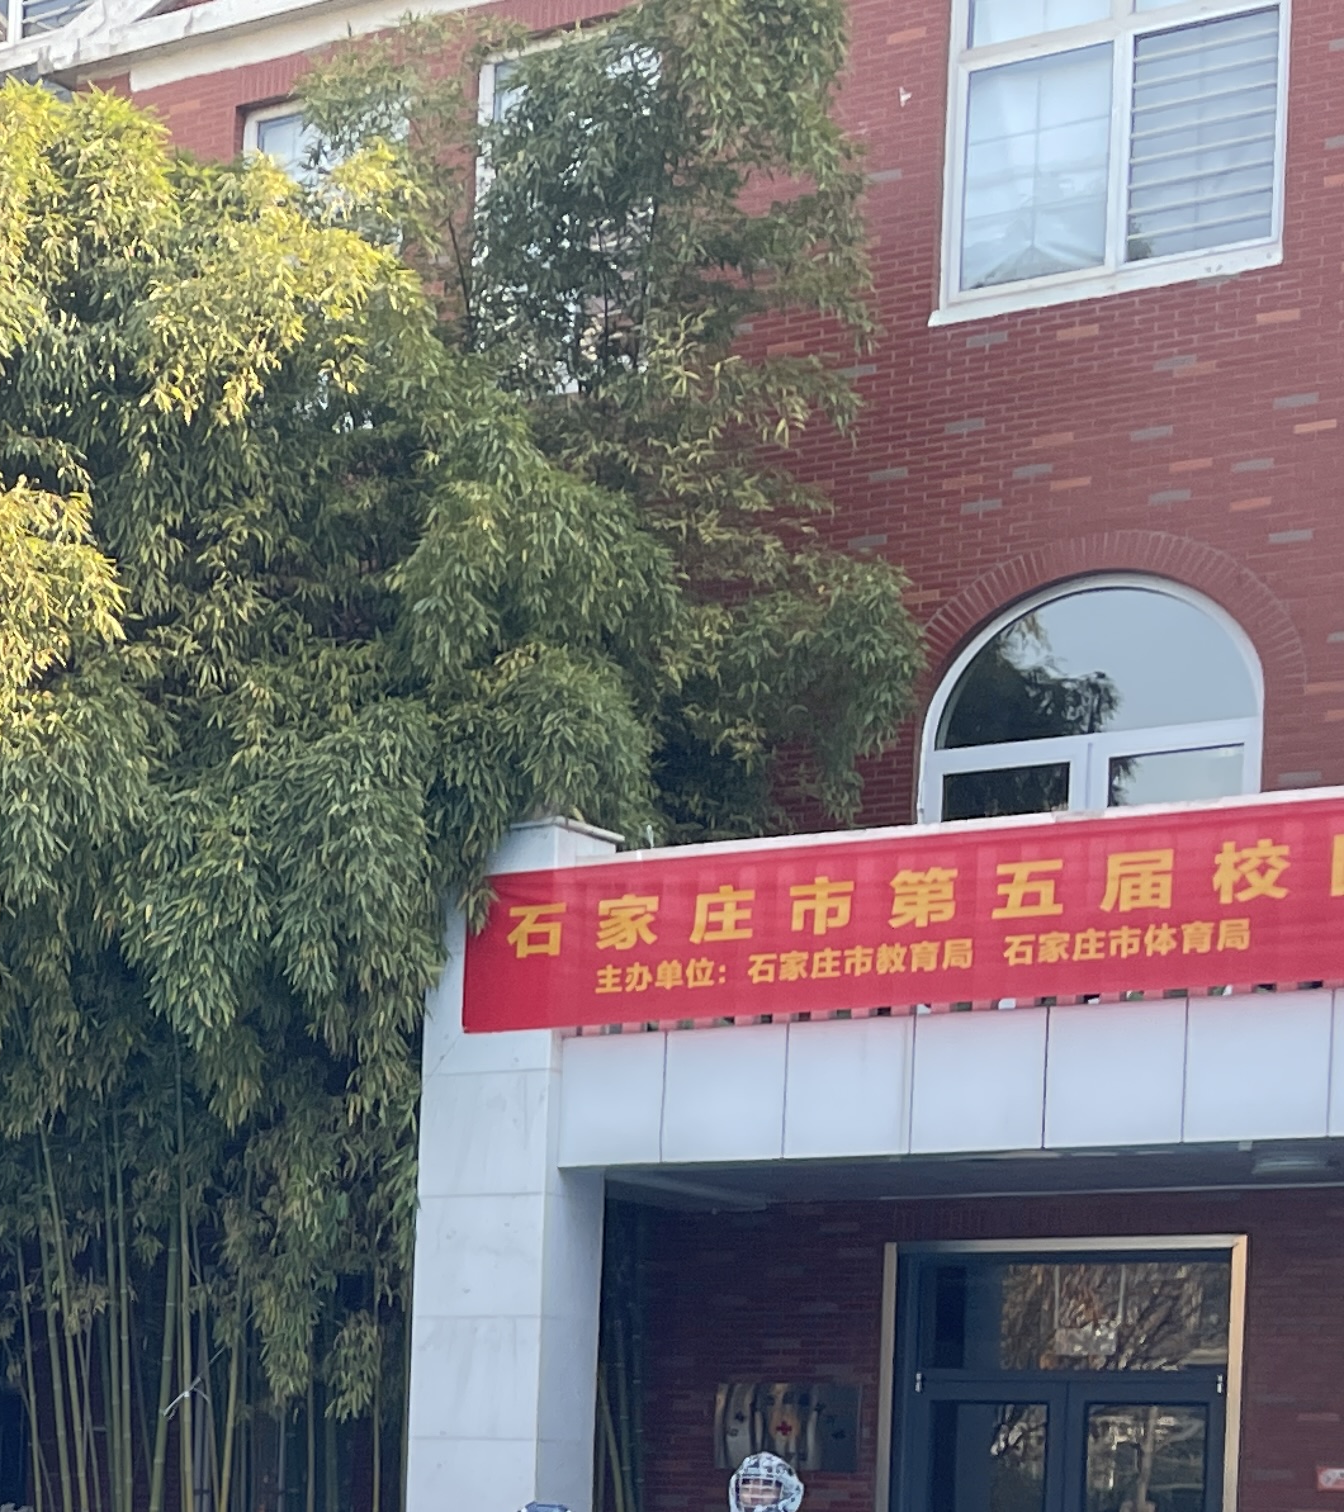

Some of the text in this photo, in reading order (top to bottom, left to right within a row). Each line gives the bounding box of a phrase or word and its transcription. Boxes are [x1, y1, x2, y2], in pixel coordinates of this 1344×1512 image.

[506, 834, 1344, 958] 石家庄市第五届校
[1003, 918, 1250, 966] 石家庄市体育局
